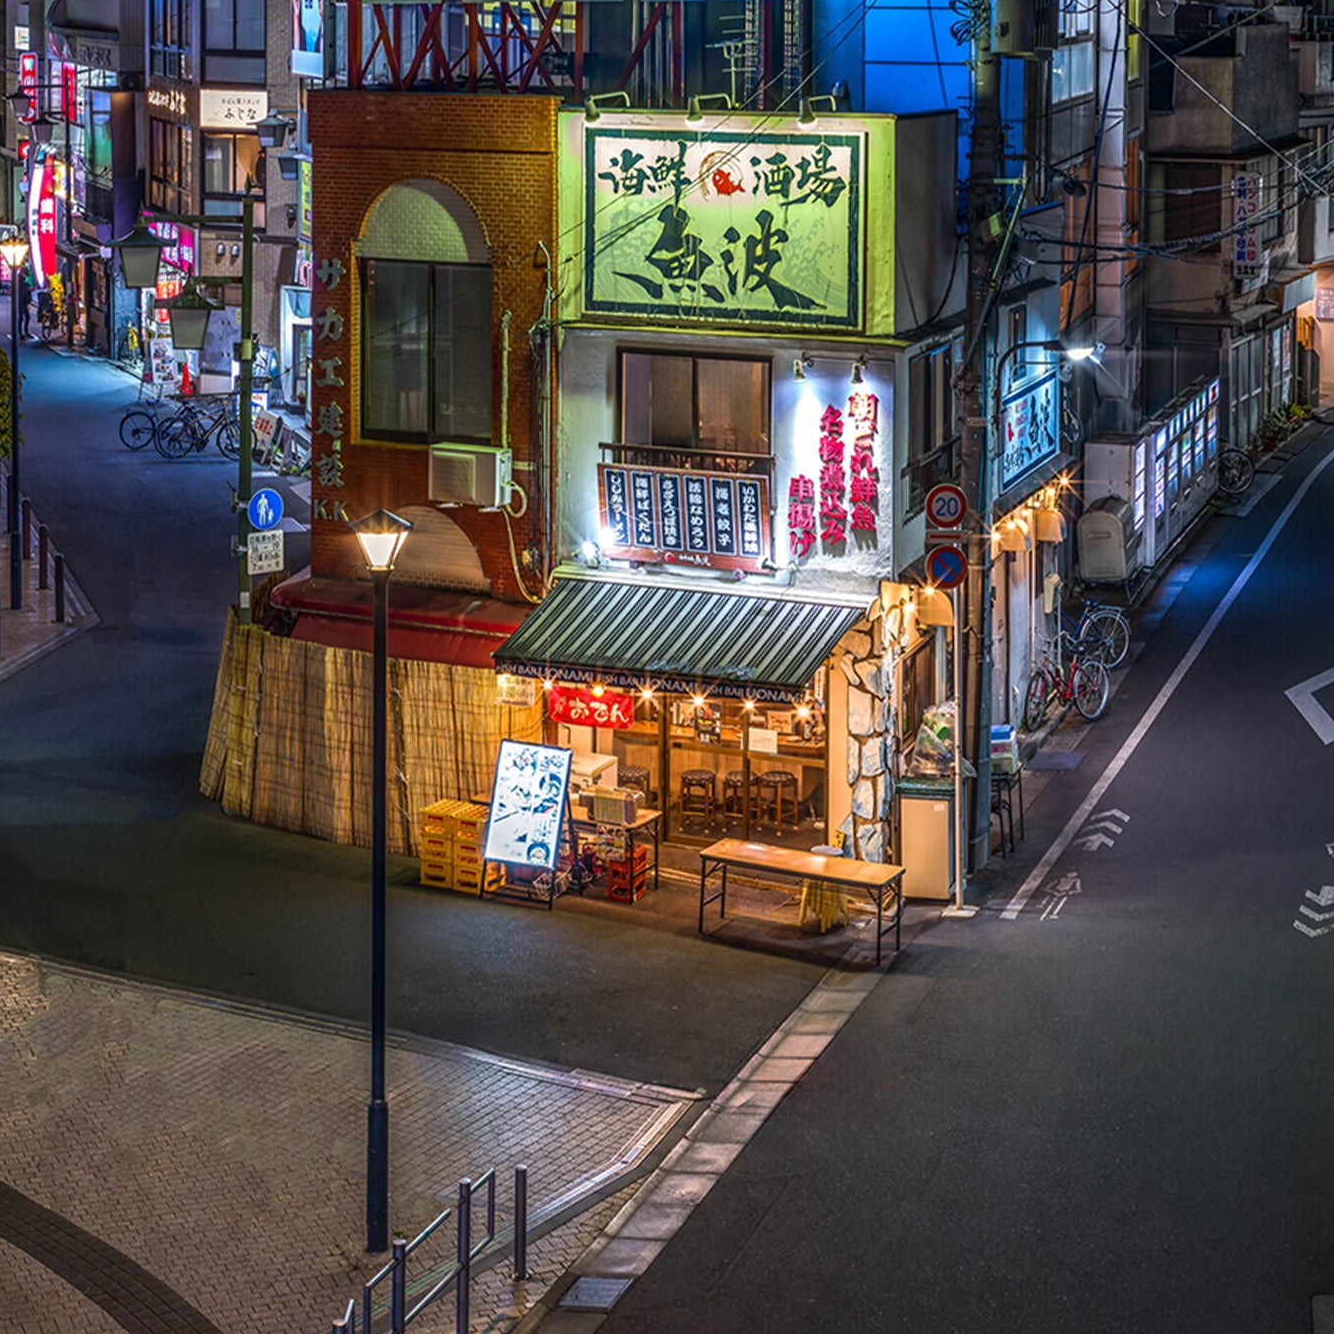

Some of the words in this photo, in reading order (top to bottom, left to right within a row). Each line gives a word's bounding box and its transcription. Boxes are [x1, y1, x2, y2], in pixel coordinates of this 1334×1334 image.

[612, 204, 827, 310] 魚波
[315, 257, 346, 487] サカエ建設
[788, 474, 816, 558] 串揚げ
[819, 404, 847, 545] 名物煮込み
[935, 497, 959, 517] 20
[538, 667, 594, 681] UONAMI
[725, 687, 746, 698] BAR
[569, 697, 629, 724] おでん
